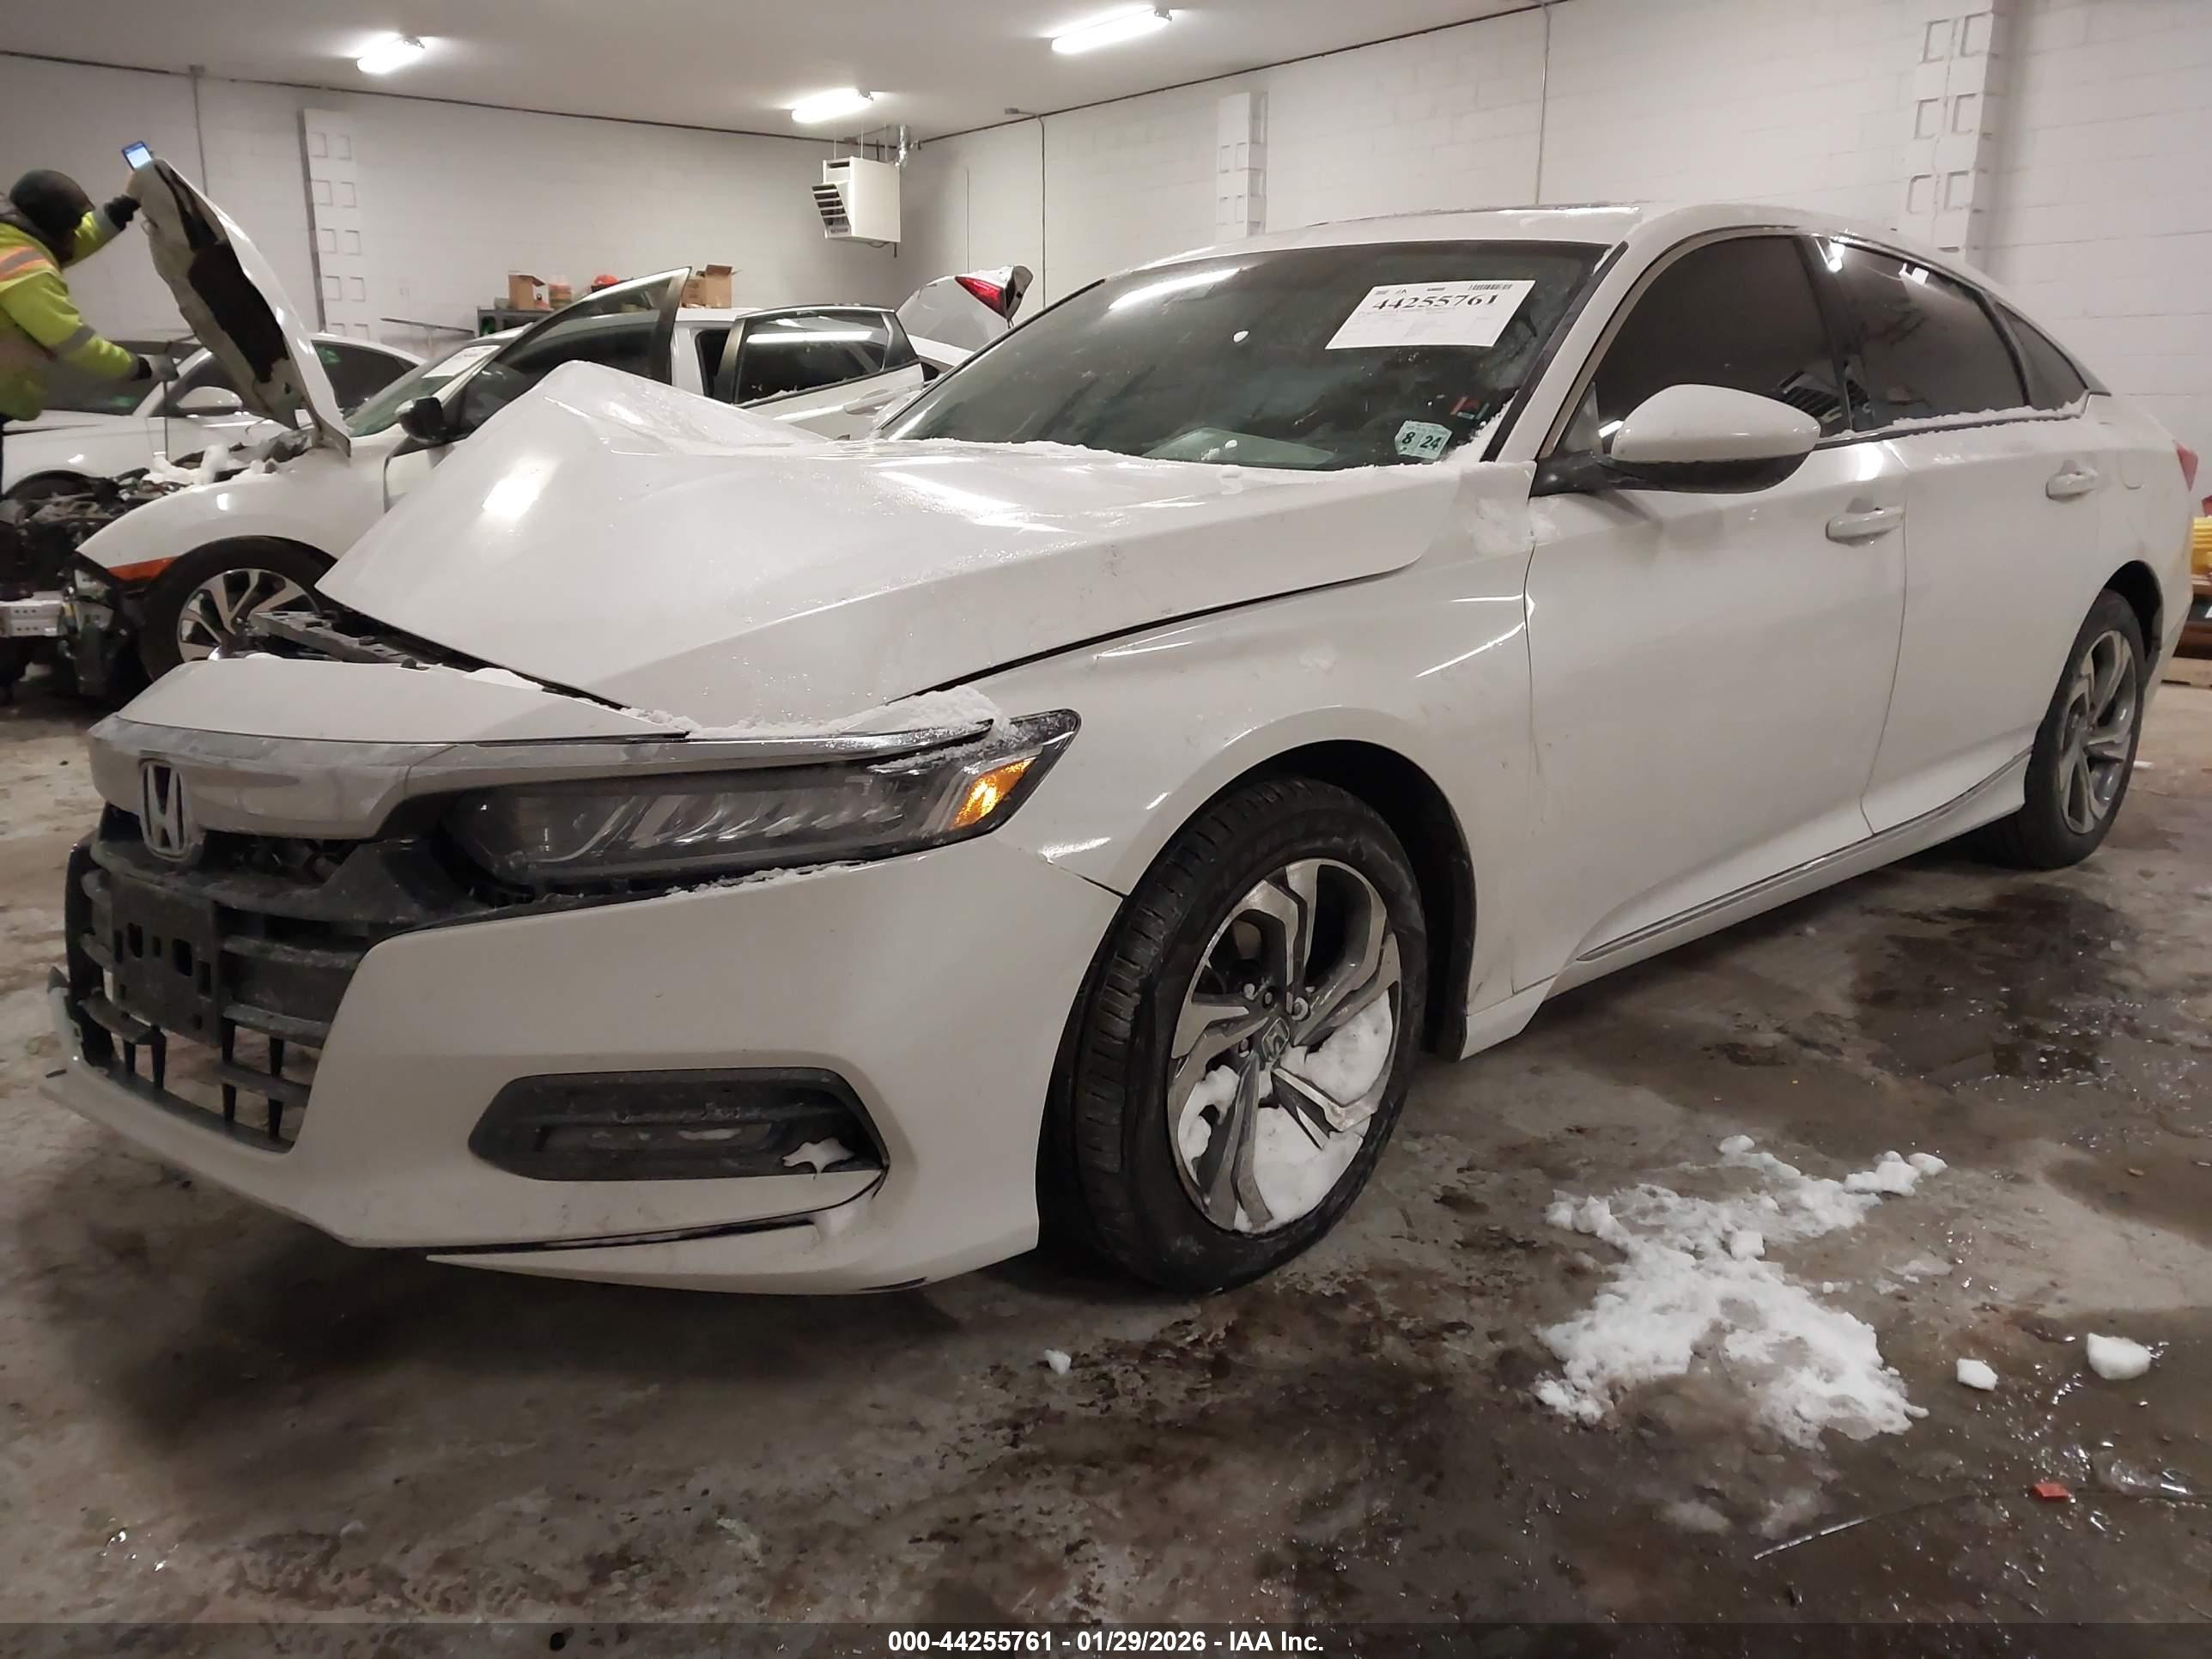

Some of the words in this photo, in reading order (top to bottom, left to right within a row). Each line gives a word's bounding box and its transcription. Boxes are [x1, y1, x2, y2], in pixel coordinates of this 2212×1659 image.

[1372, 293, 1499, 310] 44255761
[1401, 431, 1416, 445] 8
[1419, 434, 1443, 451] 24
